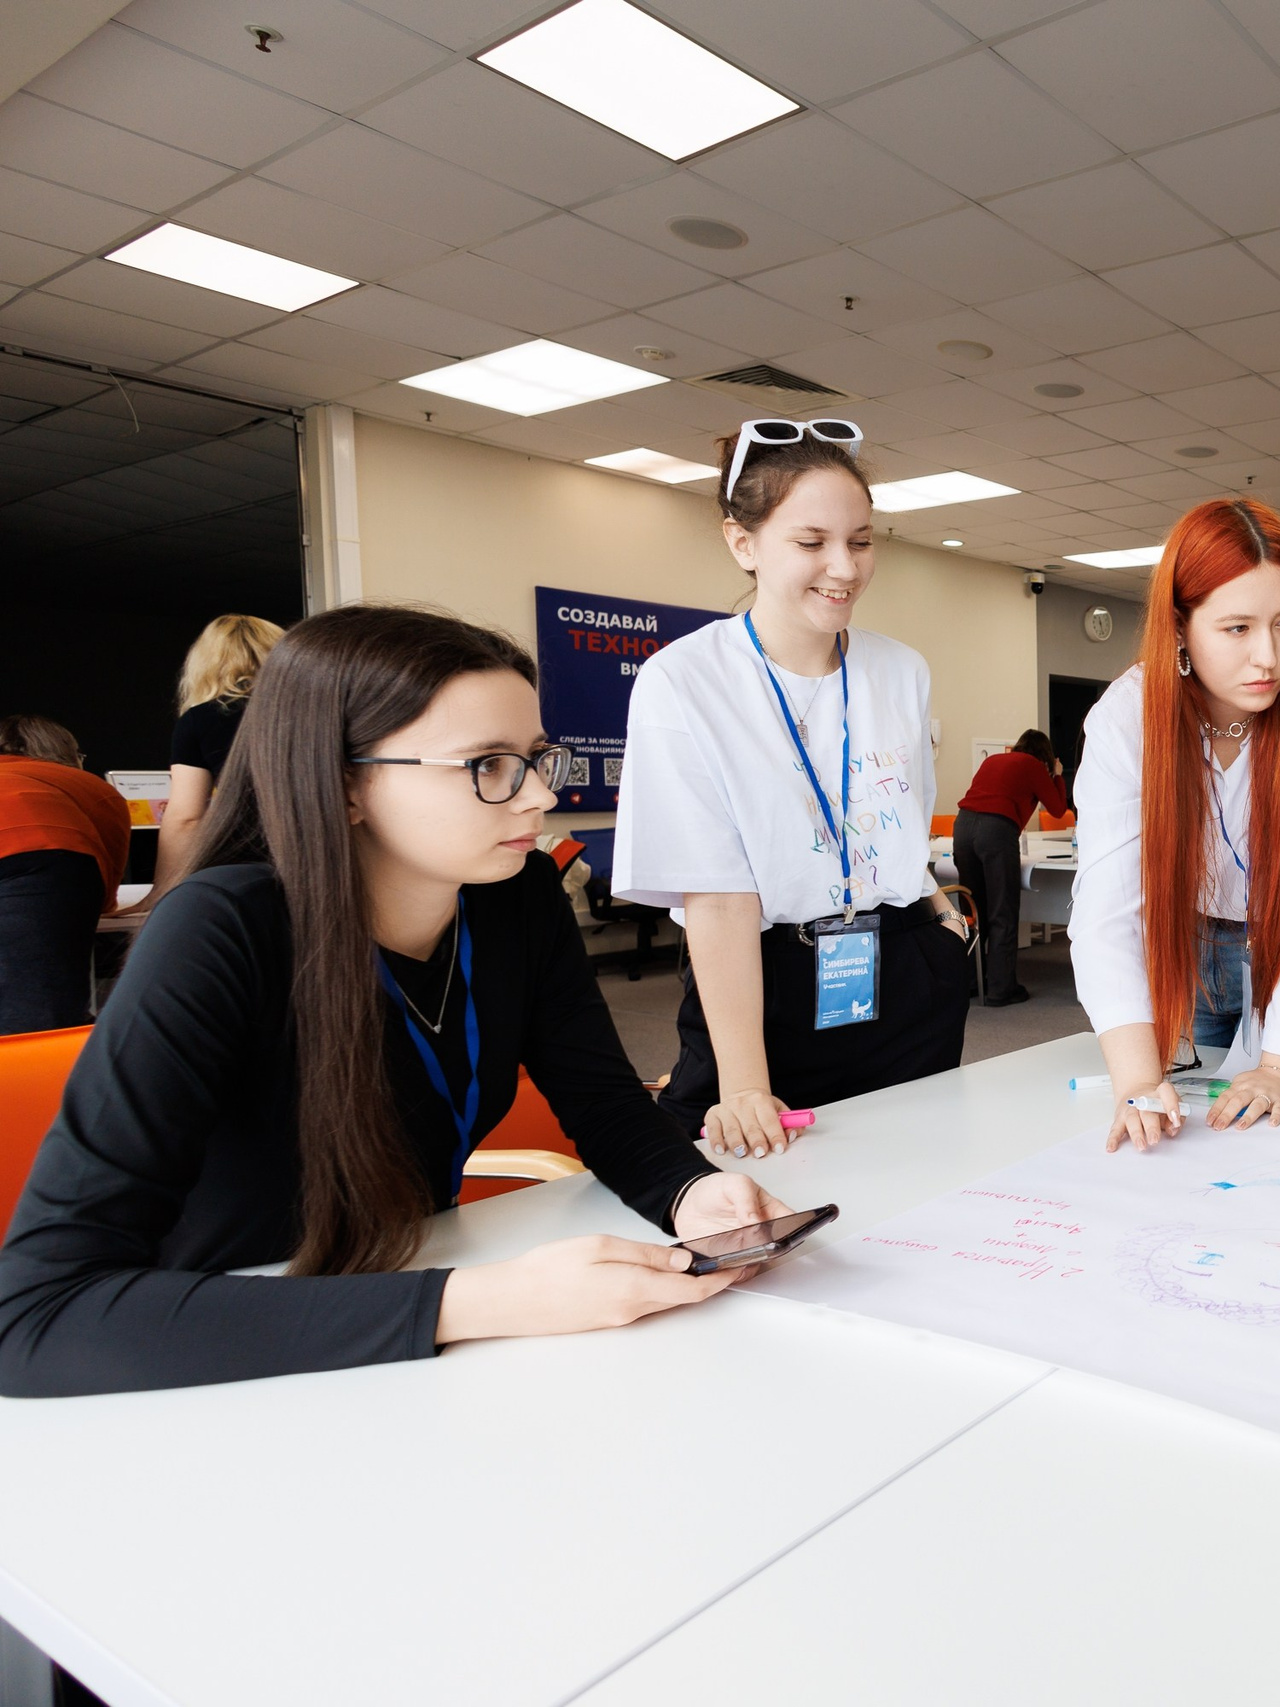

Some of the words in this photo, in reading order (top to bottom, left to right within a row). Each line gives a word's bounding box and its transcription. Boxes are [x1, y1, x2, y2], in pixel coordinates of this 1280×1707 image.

[557, 606, 658, 633] СОЗДАВАЙ
[568, 629, 671, 658] ТЕХНО
[560, 735, 586, 744] СЛЕДИ
[587, 737, 598, 745] ЗА
[823, 967, 869, 980] ЕКАТЕРИНА
